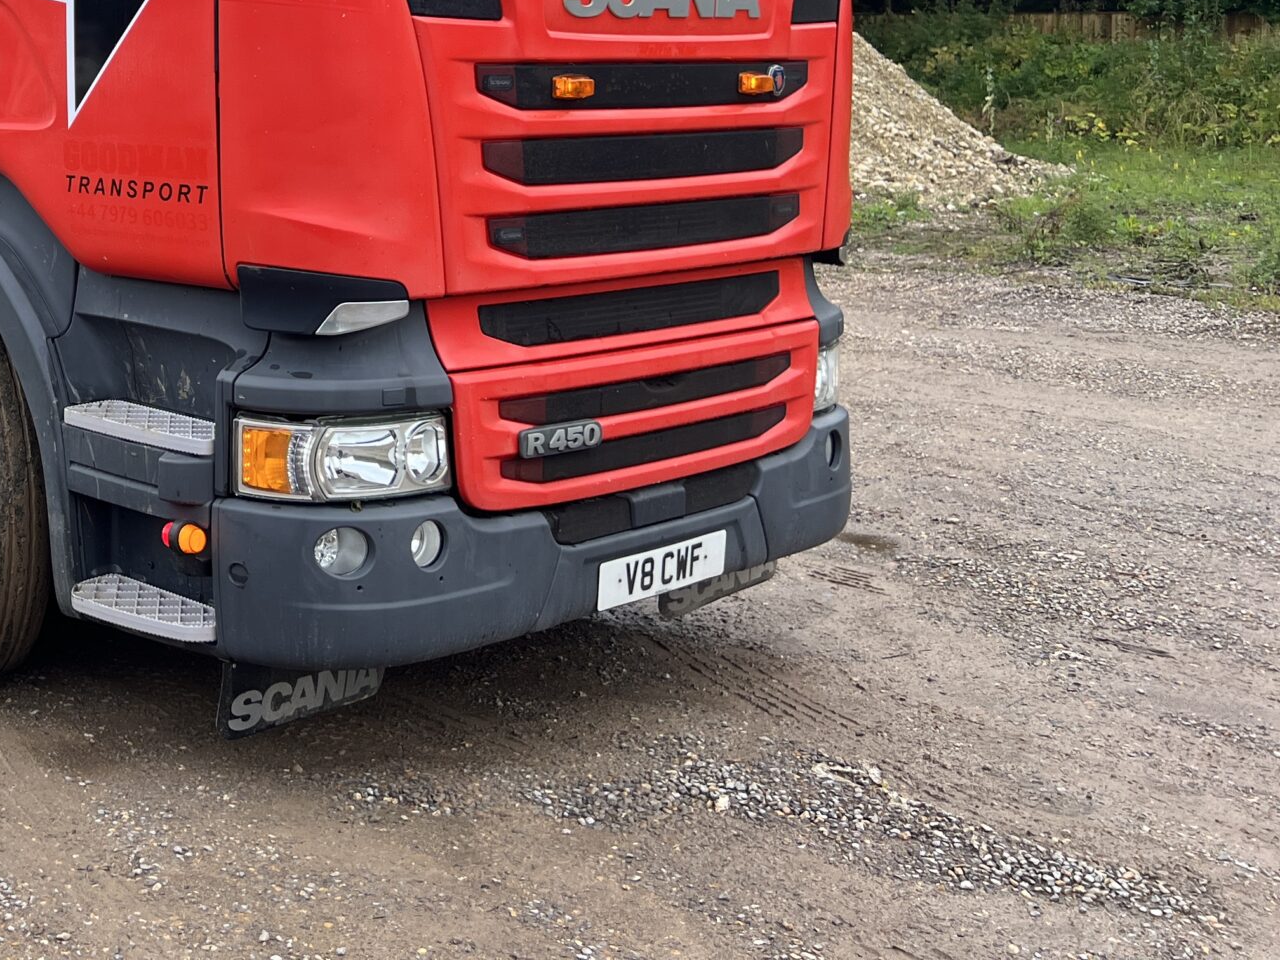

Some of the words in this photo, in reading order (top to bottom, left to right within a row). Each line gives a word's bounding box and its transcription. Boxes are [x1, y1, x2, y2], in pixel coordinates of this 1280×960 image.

[66, 175, 208, 203] TRANSPORT
[527, 432, 545, 455] R
[549, 423, 600, 450] 450
[626, 557, 654, 595] V8
[661, 542, 703, 585] CWF
[228, 668, 378, 731] SCANIA
